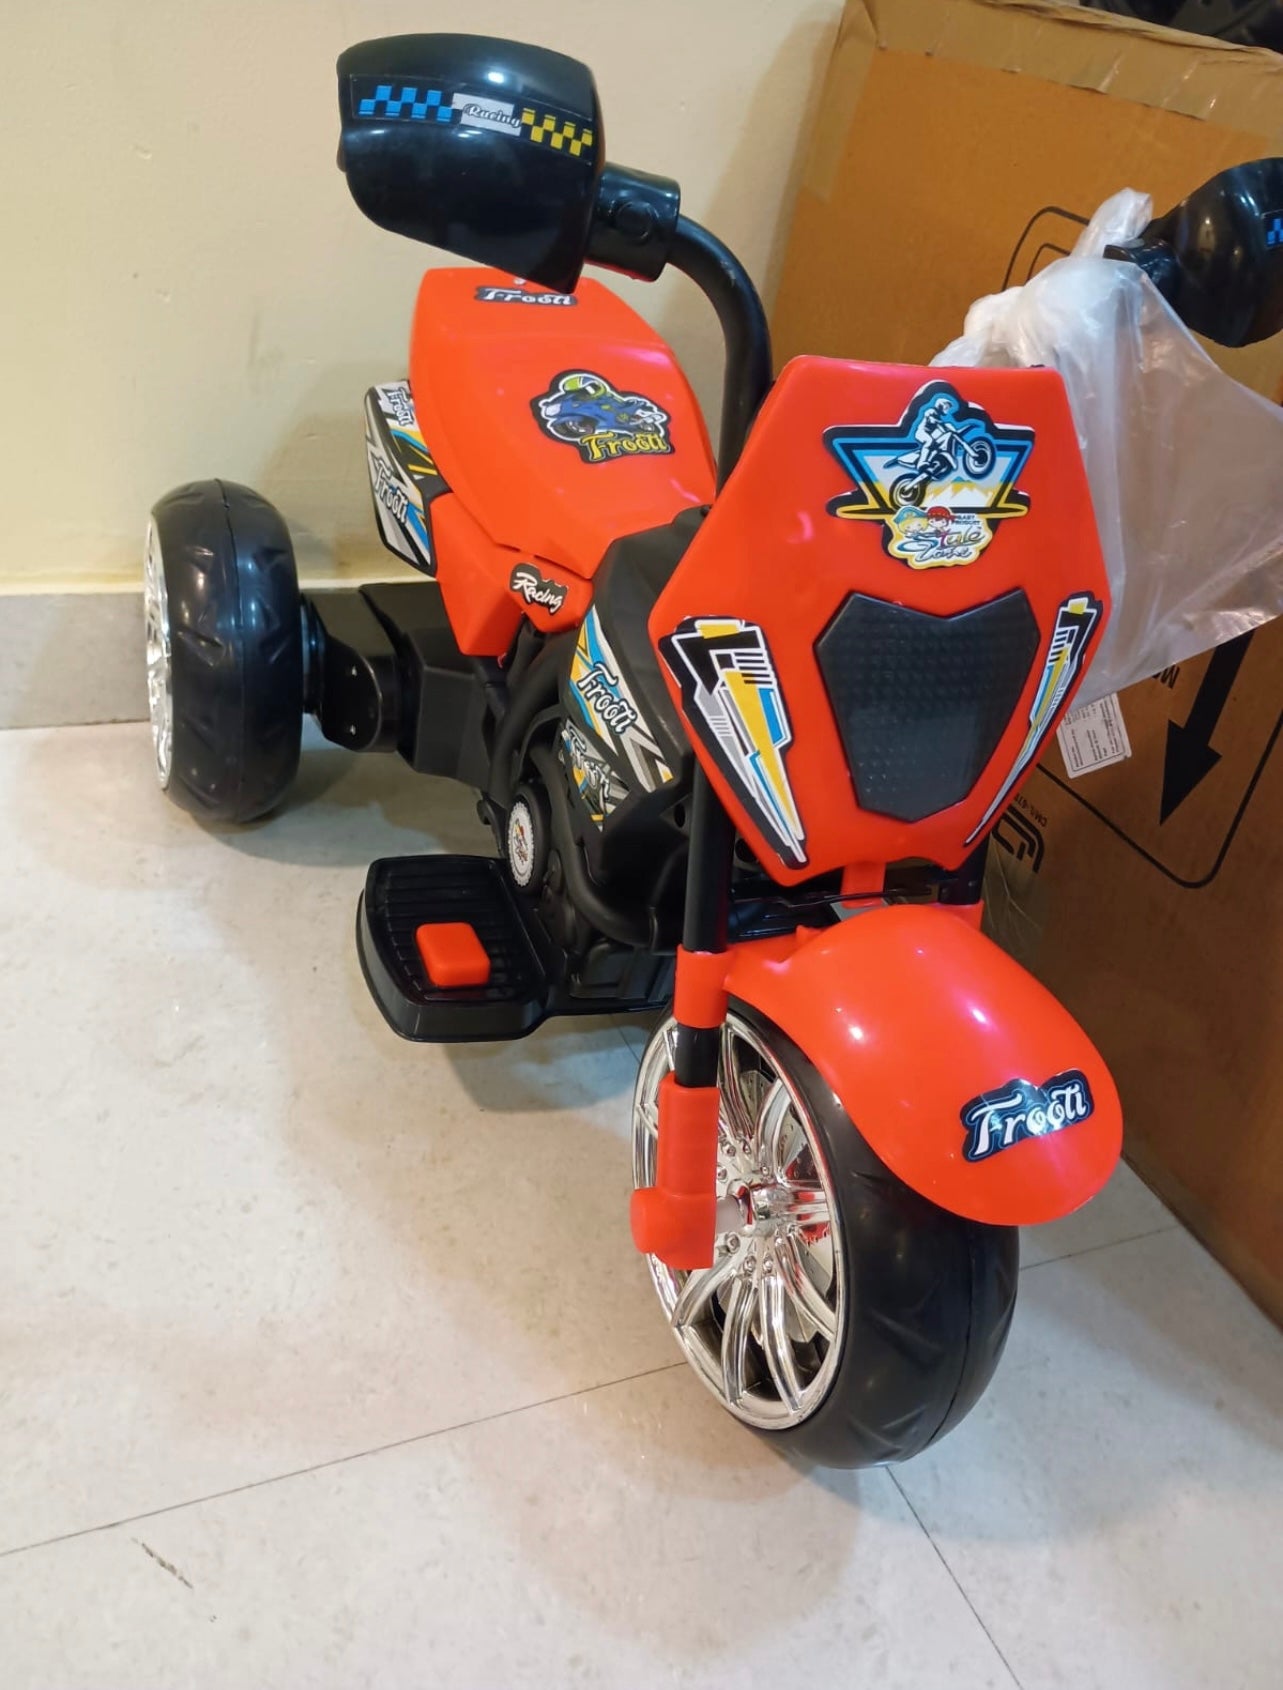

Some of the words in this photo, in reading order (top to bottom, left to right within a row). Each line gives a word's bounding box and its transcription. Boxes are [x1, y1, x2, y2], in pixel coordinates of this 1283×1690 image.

[462, 103, 521, 129] Racing
[580, 431, 668, 461] Frooti
[512, 571, 563, 614] Racing
[577, 662, 637, 734] Frooti
[970, 1083, 1087, 1156] Frooti
